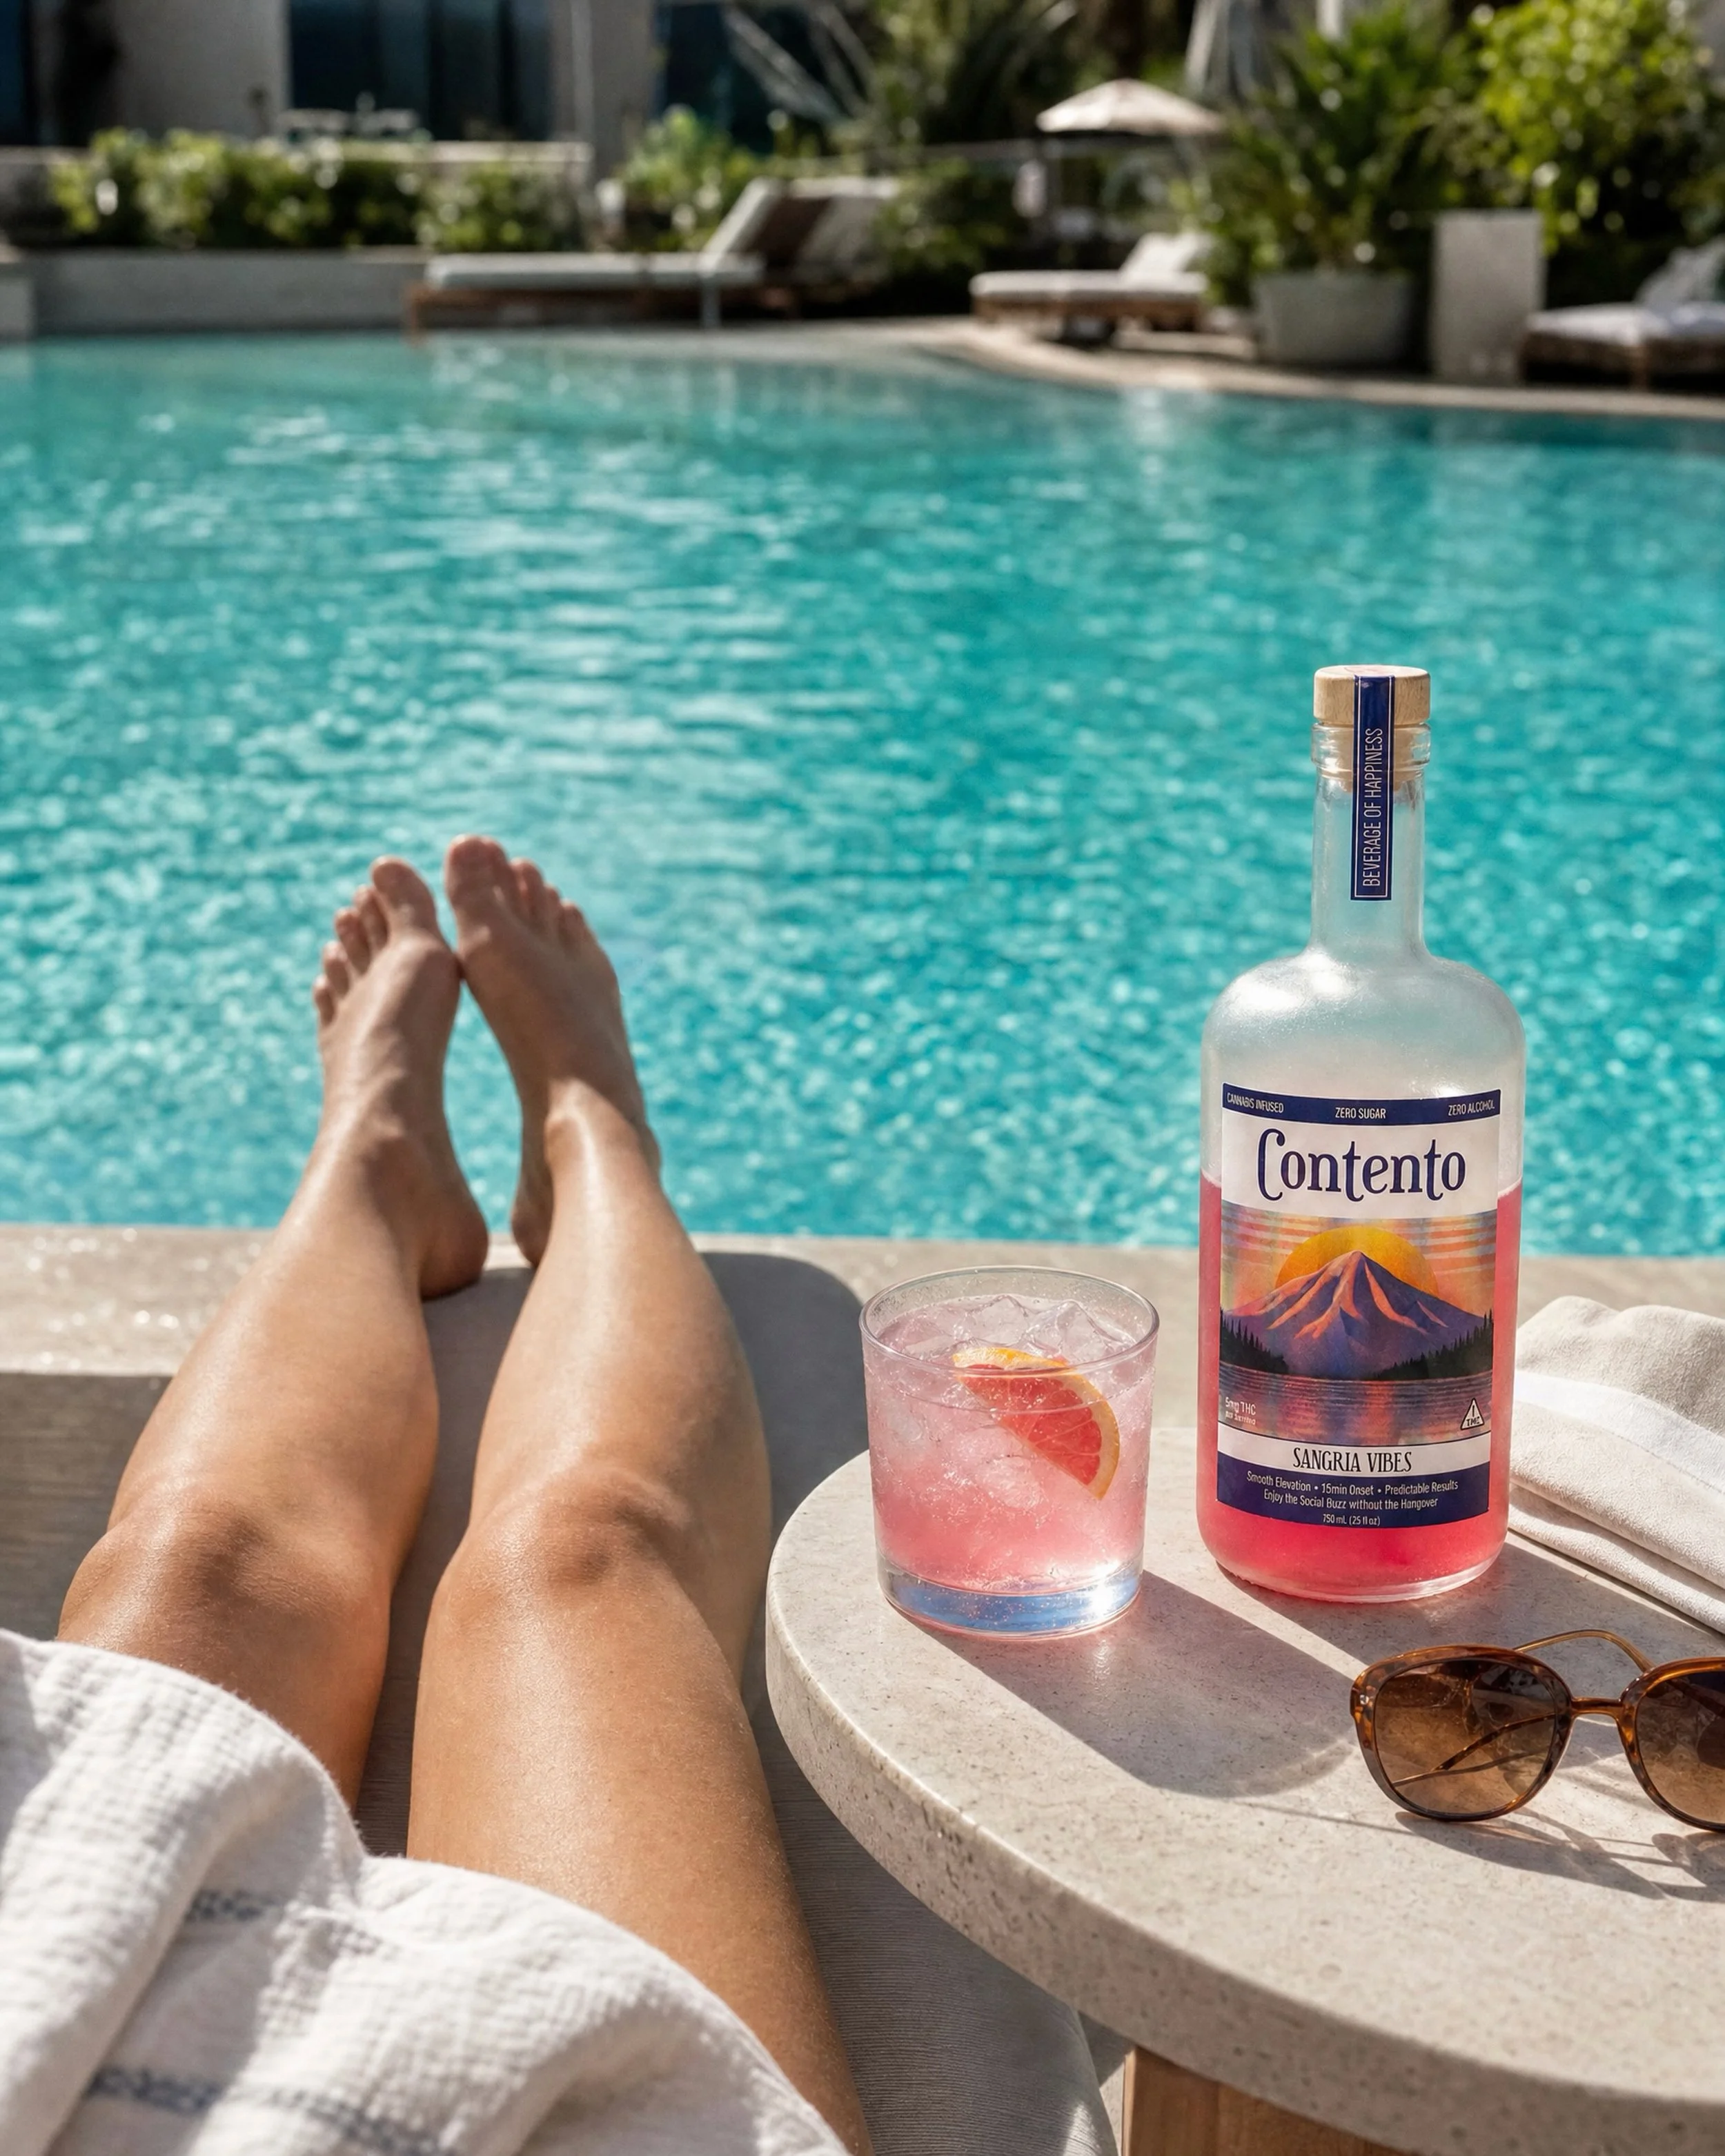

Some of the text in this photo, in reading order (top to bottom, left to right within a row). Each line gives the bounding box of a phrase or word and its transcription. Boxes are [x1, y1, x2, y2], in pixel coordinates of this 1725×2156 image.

[1363, 728, 1383, 886] BEVERAGE OF HAPPINESS
[1256, 1100, 1284, 1113] INFUSED
[1335, 1107, 1386, 1119] ZERO SUGAR
[1448, 1100, 1495, 1116] ZERO ALCOHOL
[1258, 1128, 1466, 1202] Contento
[1240, 1401, 1256, 1416] THC
[1293, 1447, 1412, 1472] SANGRIA VIBES
[1247, 1470, 1274, 1486] Smooth
[1276, 1477, 1311, 1491] Elevation
[1349, 1485, 1373, 1496] Onset
[1385, 1483, 1429, 1495] Predictable
[1431, 1479, 1459, 1492] Results
[1264, 1489, 1439, 1511] Enjoy the Social Buzz without the Hangover
[1323, 1514, 1335, 1523] 750
[1336, 1514, 1346, 1524] mL
[1349, 1516, 1361, 1525] (25
[1369, 1516, 1380, 1526] oz)
